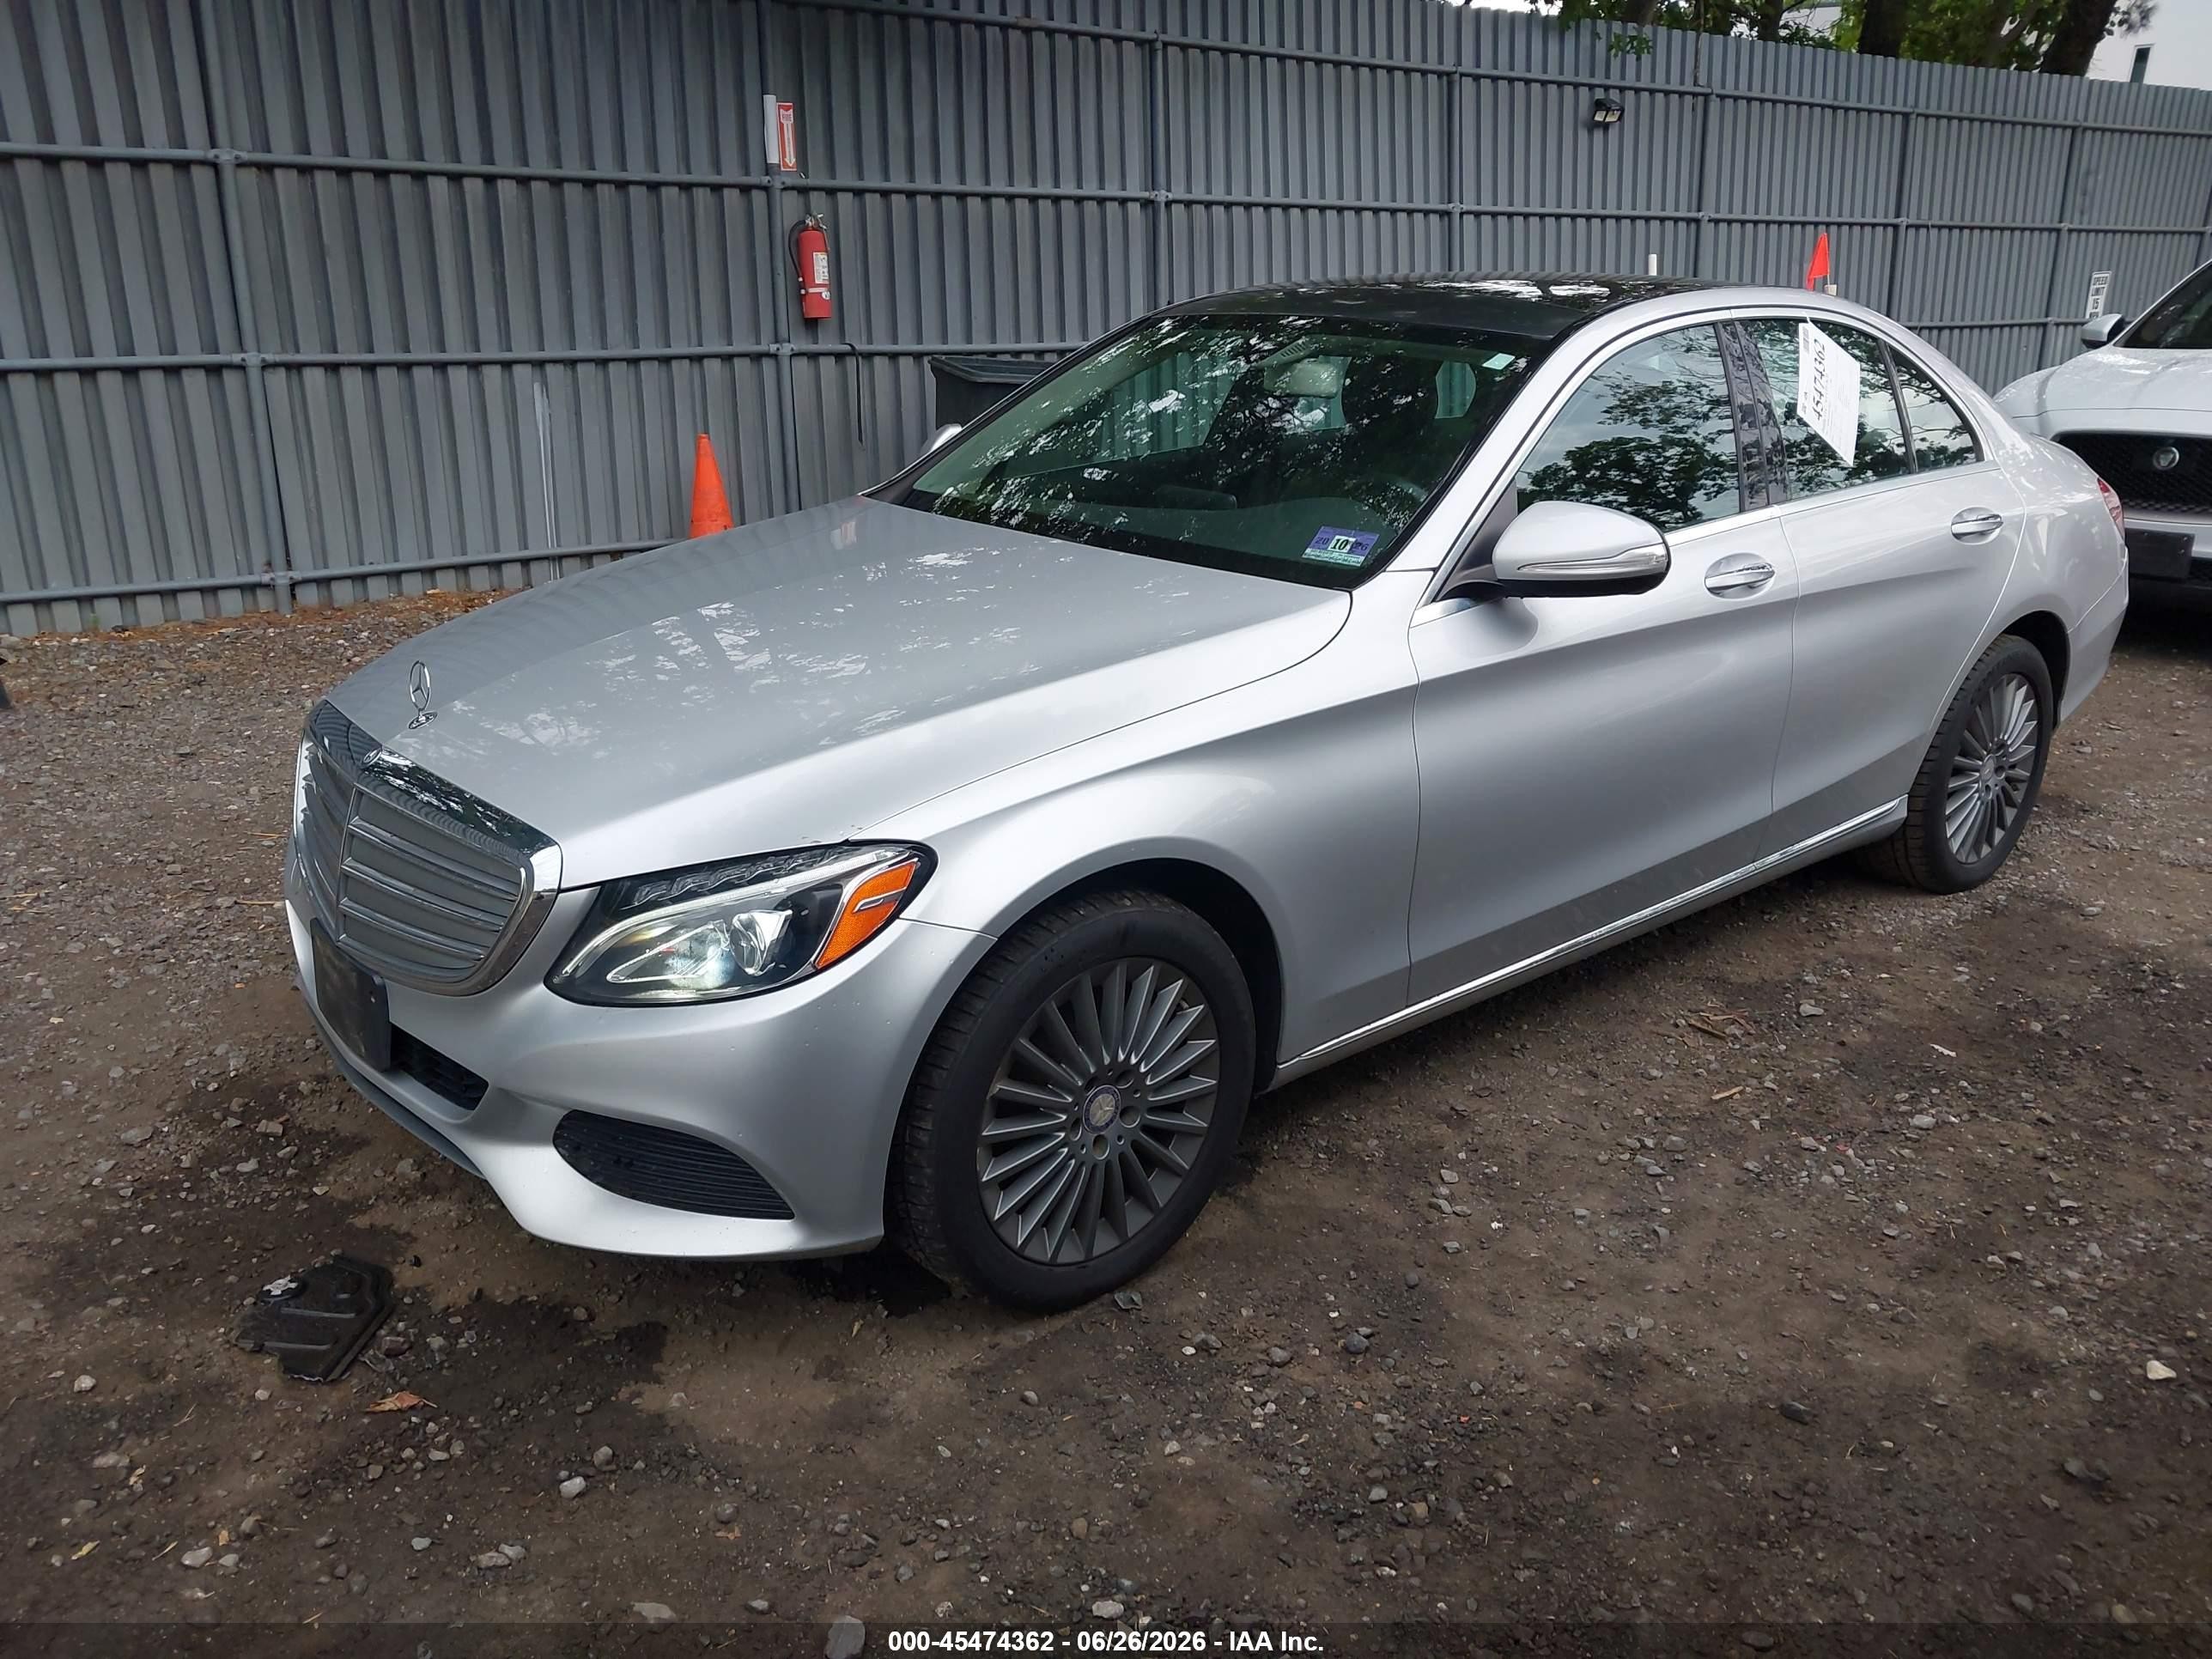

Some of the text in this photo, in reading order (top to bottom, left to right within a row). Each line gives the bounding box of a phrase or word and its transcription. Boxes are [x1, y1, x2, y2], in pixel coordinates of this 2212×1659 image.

[2093, 276, 2108, 285] SPEED
[2091, 287, 2106, 296] LIMIT
[2092, 298, 2100, 309] 15
[1811, 337, 1826, 422] 45474362
[1315, 536, 1329, 545] 20
[1330, 538, 1350, 550] 10
